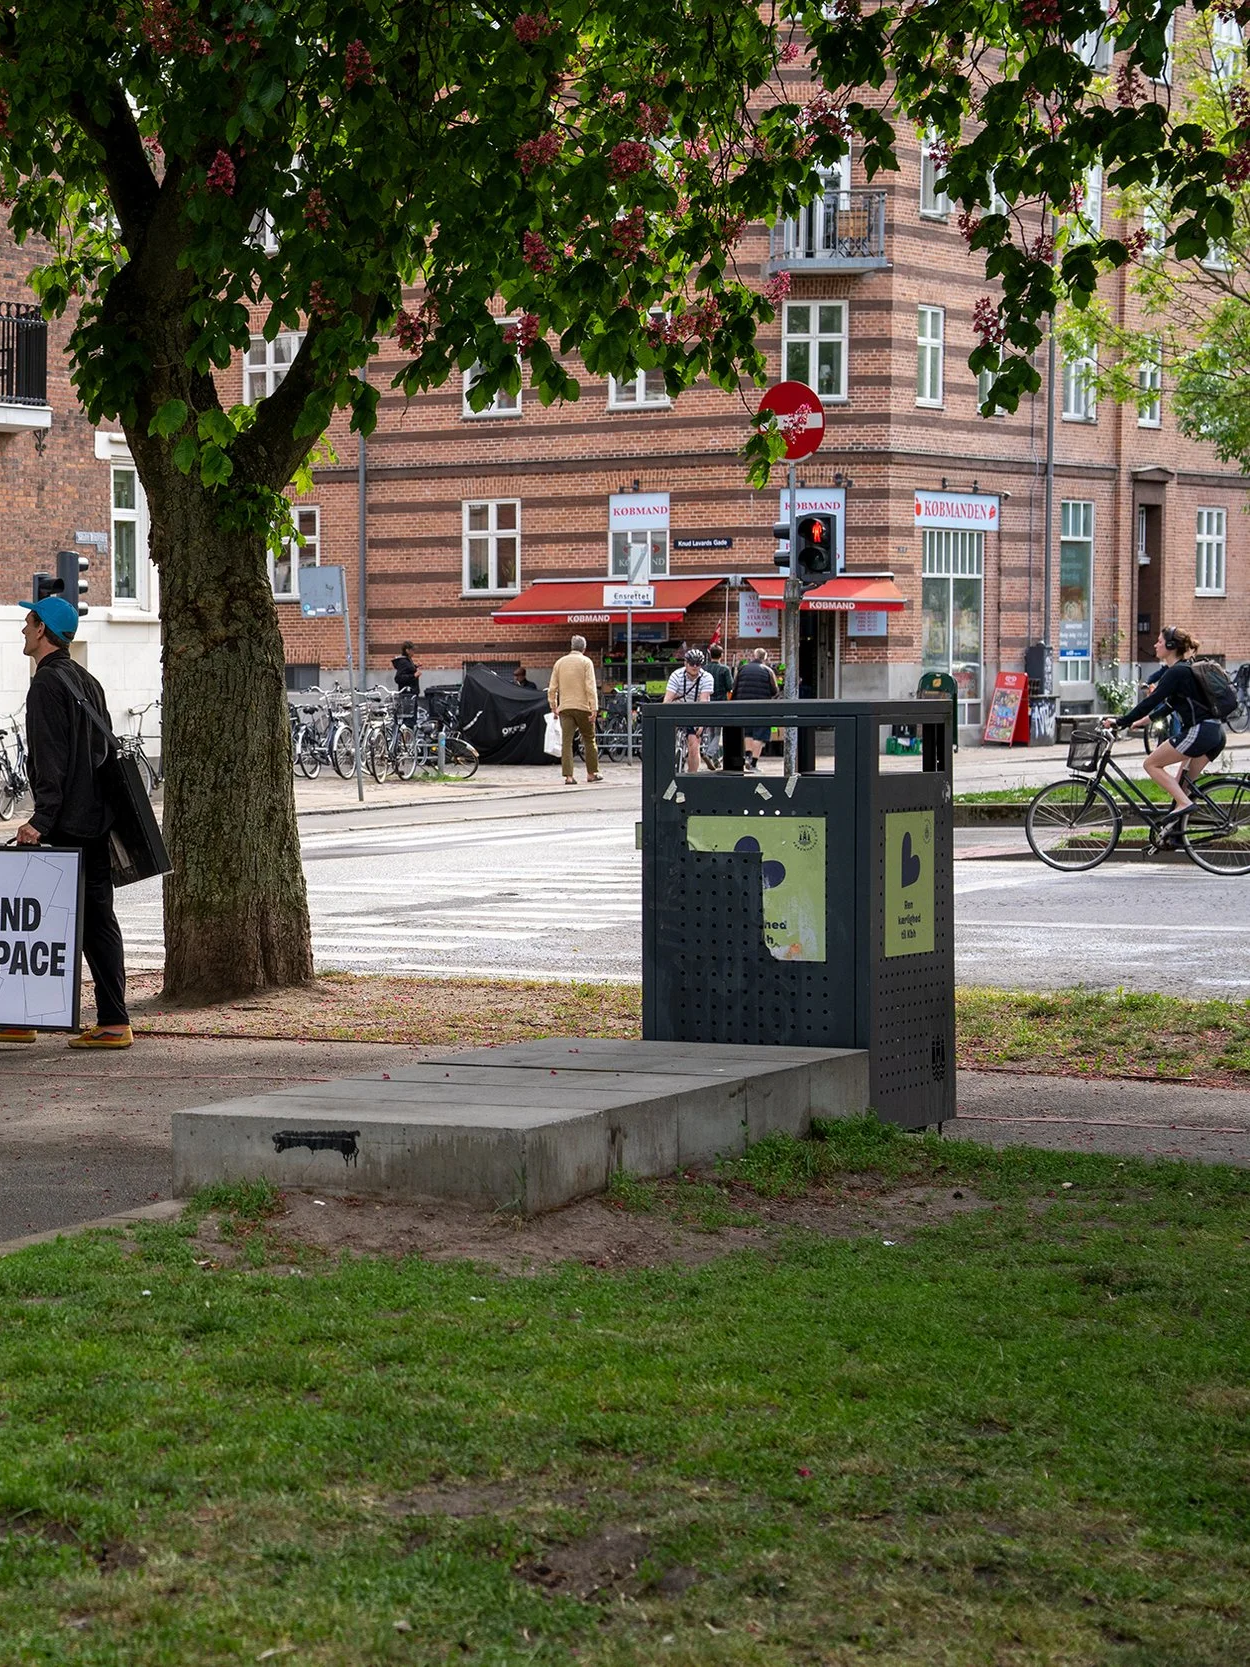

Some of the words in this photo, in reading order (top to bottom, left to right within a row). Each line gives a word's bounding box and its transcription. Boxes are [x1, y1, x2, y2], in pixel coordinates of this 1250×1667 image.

[613, 506, 668, 517] KØBMAND
[924, 500, 987, 520] KØBMANDEN
[613, 592, 650, 600] Ensrettet
[809, 601, 856, 610] KØBMAND
[567, 614, 611, 623] KØBMAND
